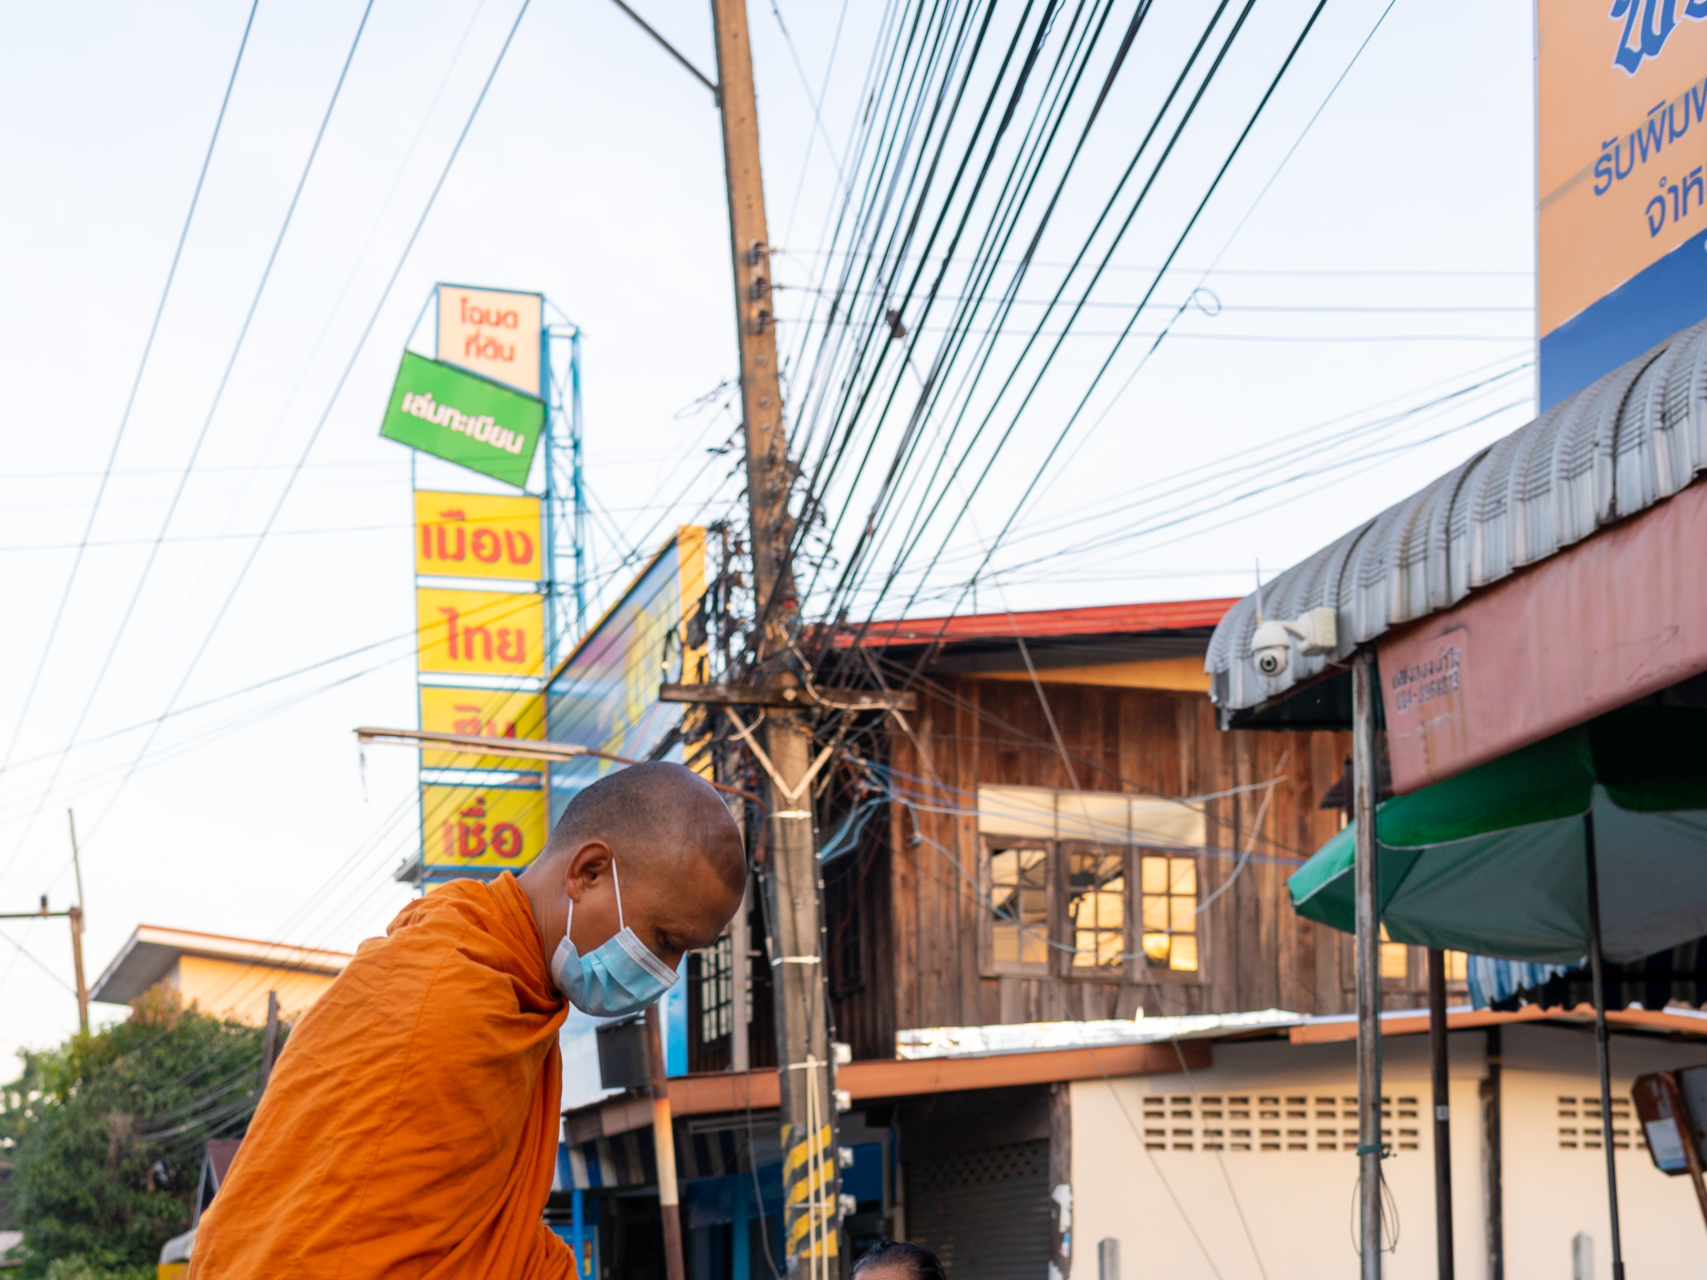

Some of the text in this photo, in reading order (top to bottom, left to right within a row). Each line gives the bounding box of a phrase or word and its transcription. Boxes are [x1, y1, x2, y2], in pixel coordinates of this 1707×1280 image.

[1645, 163, 1707, 238] จำห
[421, 509, 534, 565] เมือง
[437, 606, 527, 664] ไทย
[442, 796, 523, 859] เชื่อ
